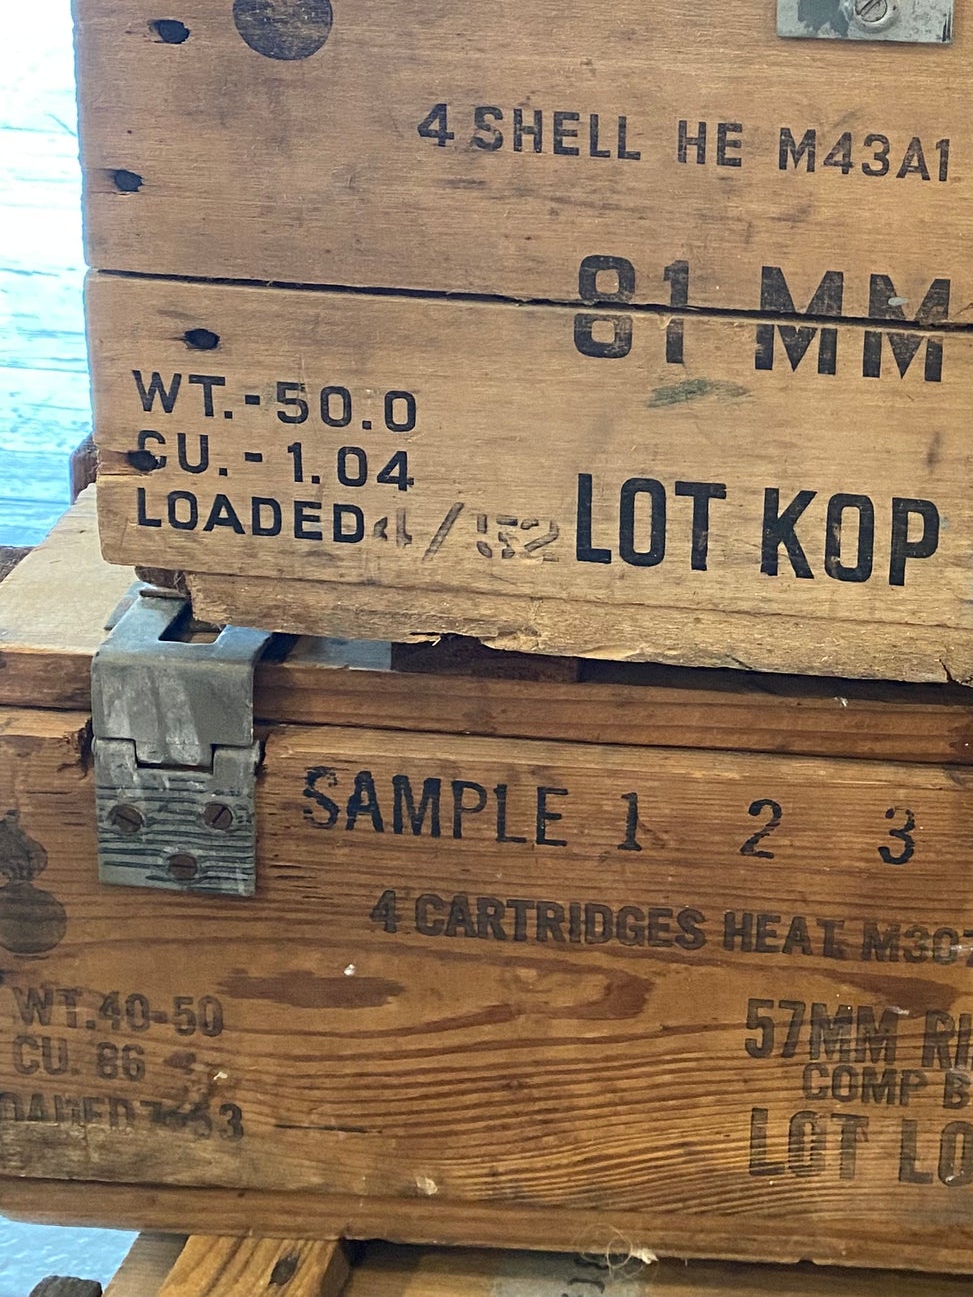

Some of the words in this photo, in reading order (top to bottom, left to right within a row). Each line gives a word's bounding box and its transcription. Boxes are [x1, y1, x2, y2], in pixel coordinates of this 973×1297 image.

[417, 103, 455, 148] 4
[473, 105, 641, 161] SHELL
[677, 119, 743, 168] HE
[777, 126, 951, 183] M43A1
[573, 254, 690, 365] 81
[754, 265, 952, 383] MM
[136, 487, 365, 544] LOADED
[576, 473, 727, 572] LOT
[759, 487, 941, 587] KOP
[303, 765, 570, 847] SAMPLE
[616, 792, 643, 851] 1
[740, 798, 783, 859] 2
[878, 806, 916, 865] 3
[369, 890, 399, 933] 4
[414, 893, 708, 950] CARTRIDGES
[723, 910, 846, 960] HEAT
[96, 1041, 147, 1083] 86
[744, 998, 899, 1066] 57MM
[802, 1062, 928, 1107] COMP
[943, 1070, 972, 1110] B
[748, 1107, 870, 1181] LOT
